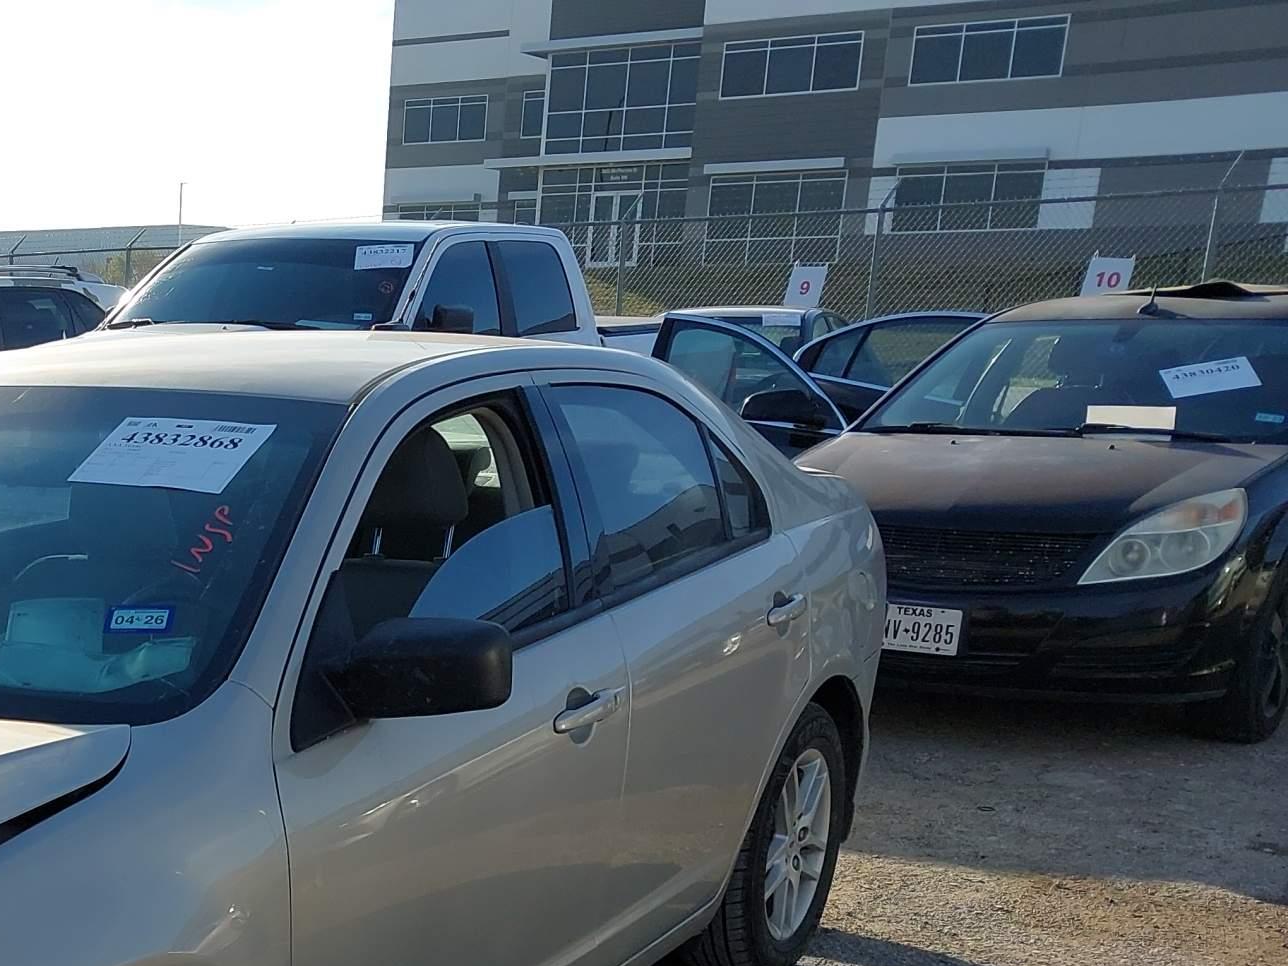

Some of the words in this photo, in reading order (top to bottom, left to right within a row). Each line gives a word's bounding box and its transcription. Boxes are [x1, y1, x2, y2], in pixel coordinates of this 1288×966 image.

[799, 280, 811, 295] 9
[1096, 271, 1121, 288] 10
[121, 430, 243, 450] 43832868
[897, 606, 933, 618] TEXAS
